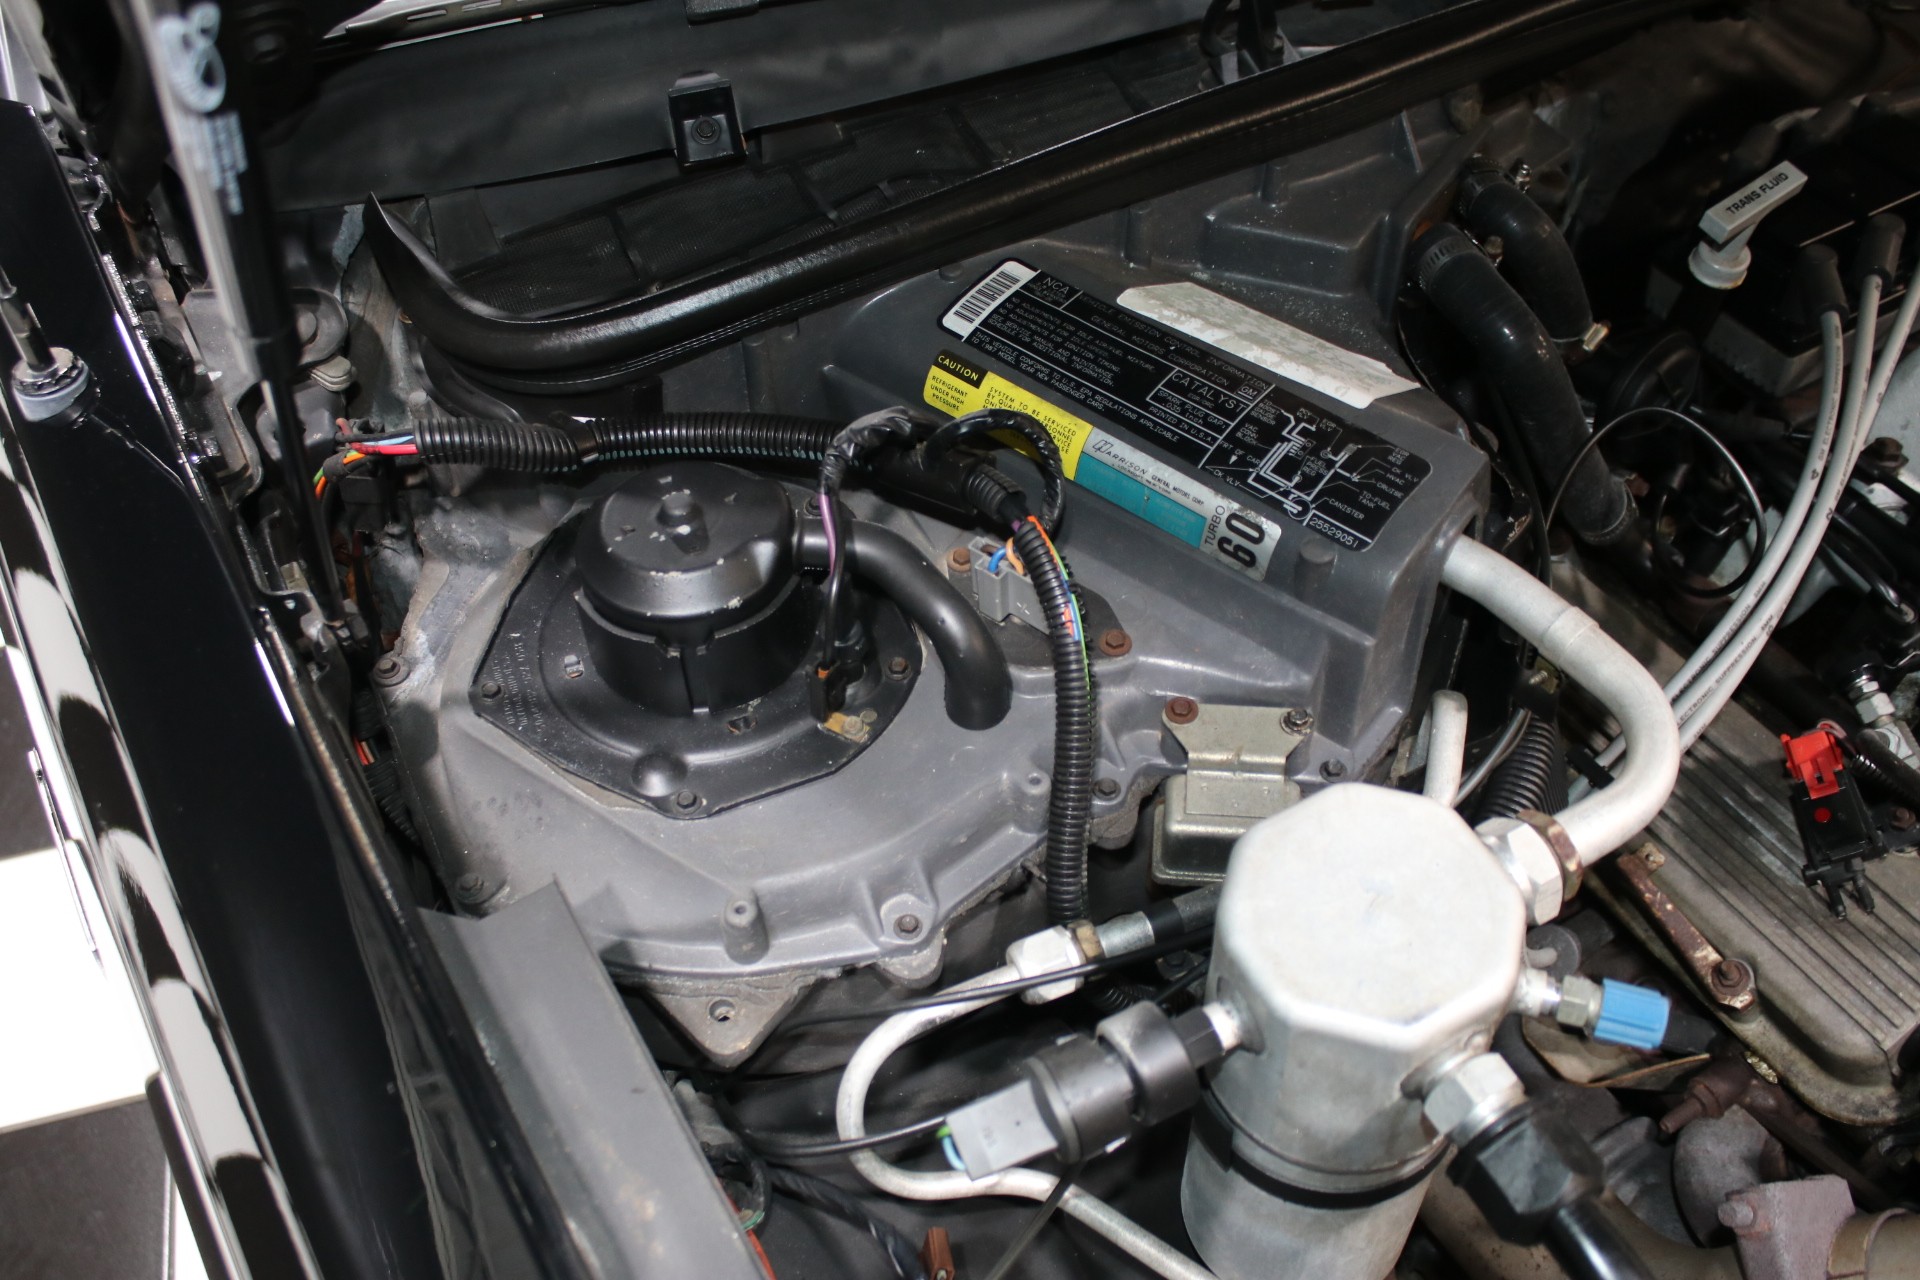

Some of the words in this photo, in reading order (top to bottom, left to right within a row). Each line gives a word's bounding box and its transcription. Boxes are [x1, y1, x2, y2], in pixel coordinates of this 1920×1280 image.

[1726, 190, 1761, 214] TRANS
[1759, 172, 1788, 193] FLUID
[1041, 276, 1071, 294] NCA
[1010, 296, 1021, 304] NO
[1020, 301, 1062, 324] ADJUSTMENTS
[1061, 322, 1076, 331] FOR
[1076, 330, 1093, 340] IDLE
[1014, 307, 1056, 330] ADJUSTMENTS
[1055, 328, 1069, 337] FOR
[990, 313, 1004, 322] SEE
[1004, 320, 1031, 336] SERVICE
[1032, 334, 1057, 349] MANUAL
[1056, 347, 1071, 357] AND
[1070, 354, 1114, 379] MAINTENANCE
[1007, 313, 1049, 336] ADJUSTMENTS
[1049, 334, 1063, 343] FOR
[1063, 341, 1095, 359] IGNITION
[1077, 293, 1116, 315] VEHICLE
[1117, 313, 1162, 337] EMISSION
[1163, 335, 1202, 357] CONTROL
[1205, 356, 1269, 390] INFORMATION
[986, 317, 1017, 336] SCHEDULE
[1017, 333, 1031, 343] FOR
[1031, 341, 1070, 363] ADDITIONAL
[1070, 361, 1116, 387] INFORMATION.
[1089, 314, 1127, 336] GENERAL
[1129, 334, 1166, 355] MOTORS
[1166, 352, 1230, 387] CORPORATION
[937, 354, 979, 381] CAUTION
[969, 336, 980, 344] TO
[980, 342, 997, 353] 1987
[996, 351, 1018, 364] MODEL
[1017, 362, 1036, 373] YEAR
[1035, 371, 1050, 381] NEW
[1049, 378, 1086, 400] PASSENGER
[1085, 397, 1107, 411] CARS.
[930, 383, 949, 397] UNDER
[950, 394, 963, 405] HIGH
[931, 374, 966, 398] REFRIGERANT
[973, 331, 991, 342] THIS
[990, 340, 1018, 357] VEHICLE
[1018, 355, 1051, 374] CONFORMS
[1061, 377, 1078, 388] U.S.
[1079, 387, 1094, 396] EPA
[1093, 394, 1138, 420] REGULATIONS
[1137, 417, 1179, 442] APPLICABLE
[986, 392, 994, 400] BY
[1169, 371, 1247, 415] CATALYST
[1239, 385, 1257, 397] GM
[931, 392, 960, 411] PRESSURE
[989, 386, 1014, 403] SYSTEM
[1018, 401, 1027, 410] TO
[1031, 408, 1039, 417] BE
[1043, 415, 1076, 437] SERVICED
[1156, 389, 1183, 406] SPARK
[1183, 403, 1206, 417] PLUG
[1161, 400, 1182, 413] .035
[1147, 406, 1178, 424] PRINTED
[1178, 422, 1189, 430] IN
[1189, 428, 1216, 444] U.S.A.
[1243, 422, 1258, 432] VAC
[1249, 410, 1276, 426] SENSOR
[1239, 426, 1258, 439] CONN
[1218, 440, 1233, 450] FRT
[1233, 448, 1245, 456] OF
[1245, 454, 1261, 465] CAR
[1309, 456, 1329, 469] FUEL
[1212, 469, 1223, 477] CK
[1224, 475, 1240, 486] VLV
[1301, 466, 1316, 476] REG
[1304, 461, 1328, 475] PRESS
[1385, 472, 1405, 485] HVAC
[1151, 474, 1169, 488] GENERAL
[1173, 486, 1189, 499] MOTORS
[1374, 481, 1404, 499] CRUISE
[1327, 497, 1365, 520] CANISTER
[1356, 495, 1376, 508] TANK
[1204, 506, 1224, 545] TURBO
[1308, 516, 1360, 548] 25529051
[1218, 513, 1264, 567] 60
[1711, 604, 1751, 657] SUPPRESSION
[1715, 636, 1757, 684] SUPPRESSION
